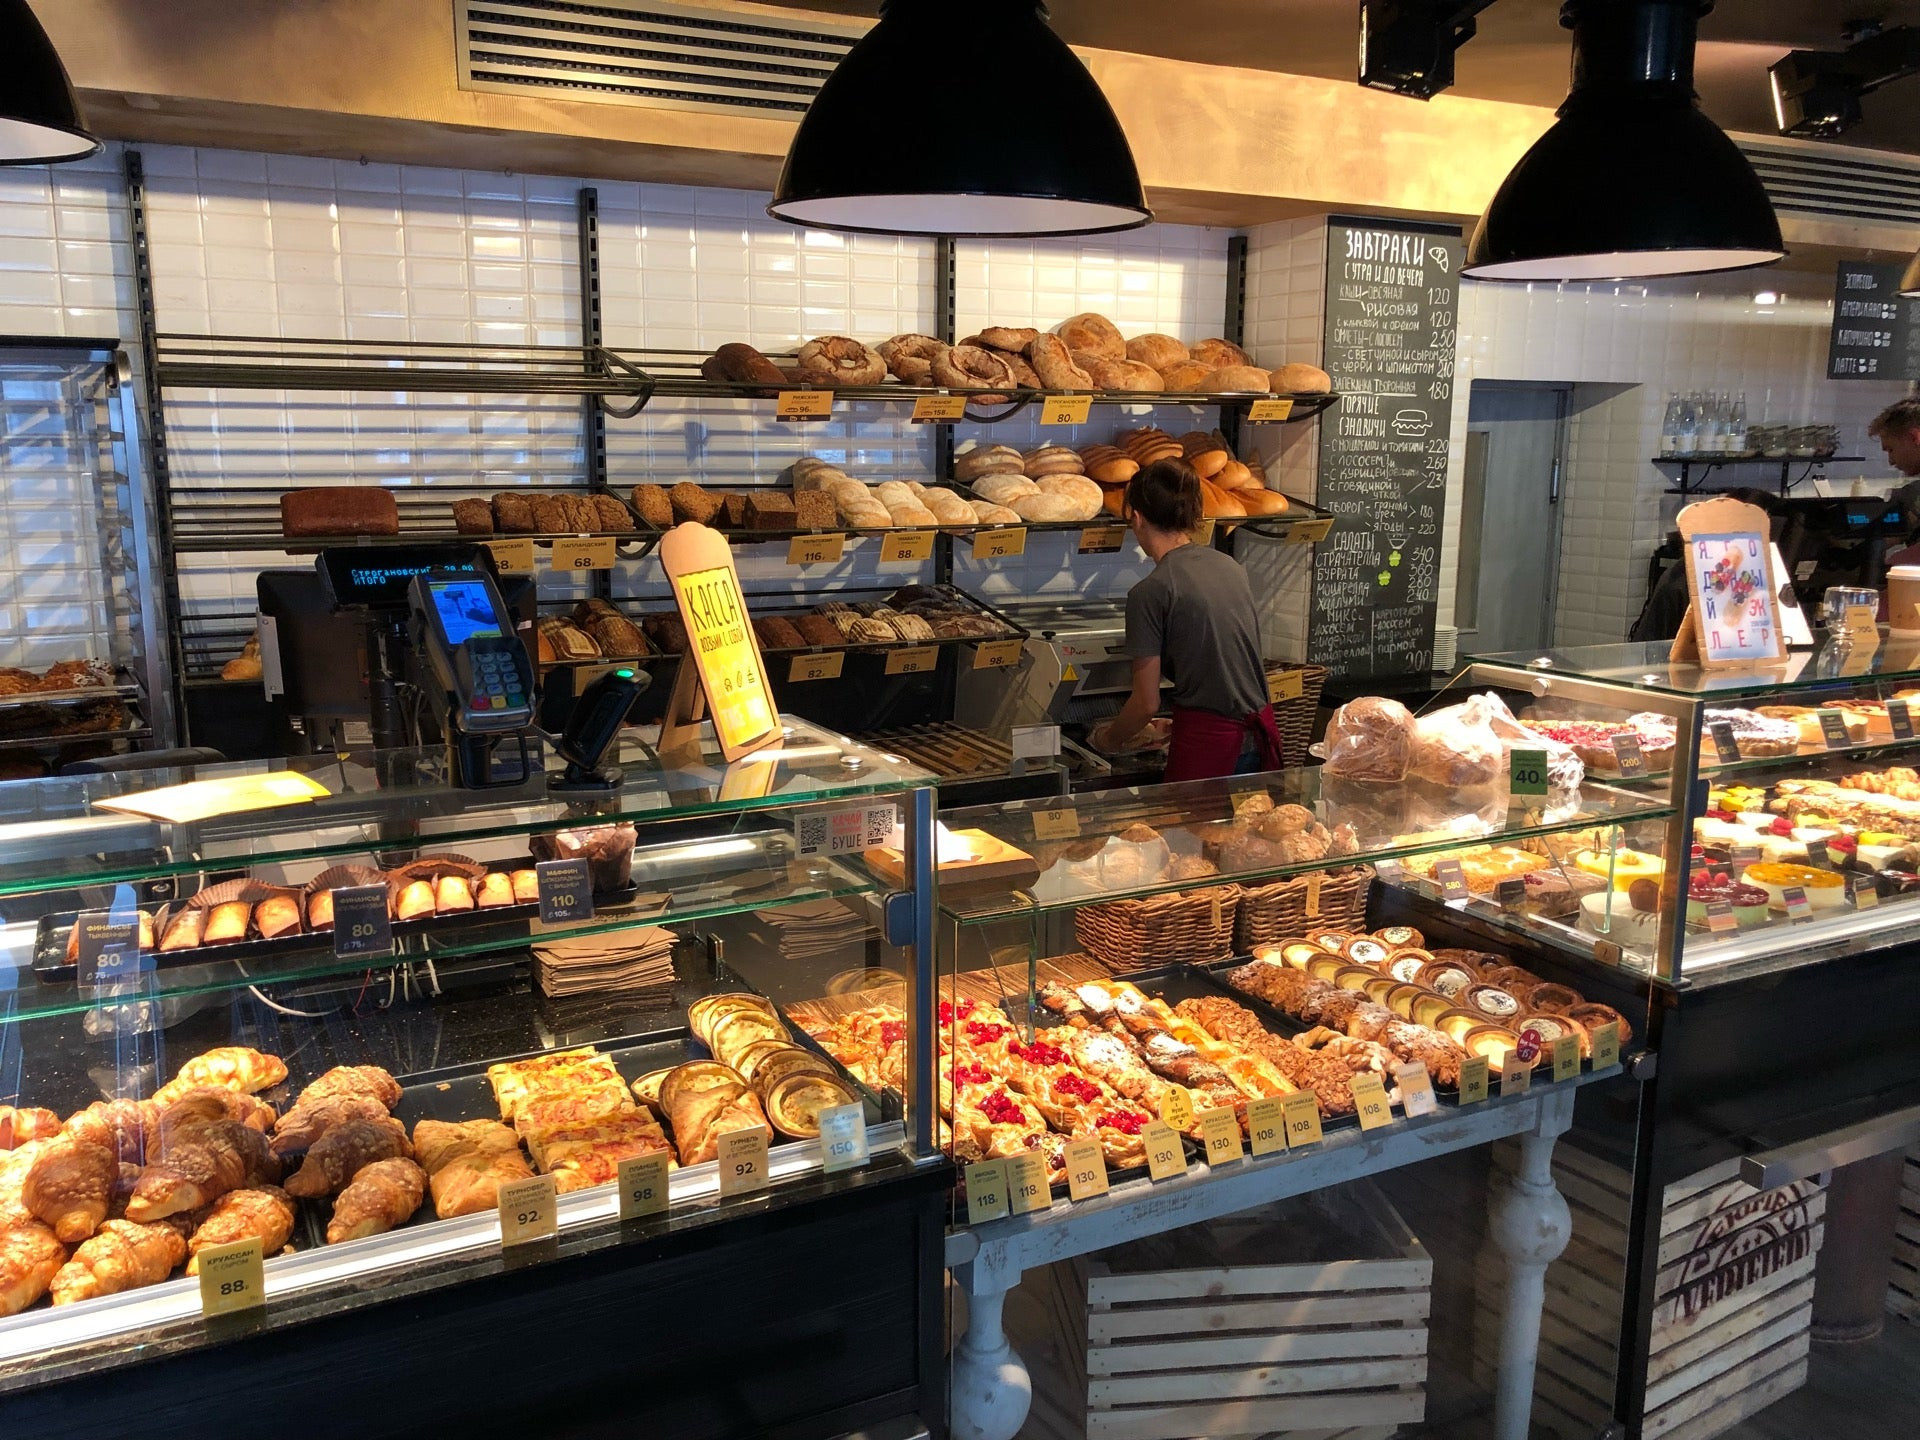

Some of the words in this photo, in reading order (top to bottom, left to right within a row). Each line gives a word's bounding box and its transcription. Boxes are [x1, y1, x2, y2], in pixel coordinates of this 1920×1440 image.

[1345, 230, 1425, 266] ЗАВТРАКИ
[1344, 263, 1349, 279] С
[1352, 264, 1372, 281] УТРА
[1374, 265, 1382, 282] И
[1382, 266, 1396, 284] ДО
[1397, 267, 1424, 287] ВЕЧЕРА
[1340, 283, 1362, 299] КАШИ
[1368, 285, 1403, 300] ОВСЯНАЯ
[1427, 287, 1450, 305] 120
[1366, 302, 1418, 317] РИСОВАЯ
[1430, 311, 1452, 327] 120
[1430, 329, 1455, 348] 250
[1355, 348, 1402, 361] ВЕТЧИНОЙ
[1411, 349, 1438, 361] СЫРОМ
[1438, 348, 1455, 362] 220
[1834, 357, 1857, 374] ЛАТТЕ
[1333, 376, 1372, 391] ЗАПЕКАНКА
[1374, 378, 1416, 392] ТВОРОЖНАЯ
[1427, 381, 1449, 400] 180
[1341, 395, 1380, 415] ГОРЯЧИЕ
[1057, 413, 1071, 422] 80
[1339, 416, 1386, 438] СЭНДВИЧИ
[1331, 439, 1338, 451] С
[1428, 438, 1449, 453] 220
[1338, 455, 1385, 467] ЛОСОСЕМ
[1426, 456, 1447, 470] 260
[1339, 467, 1386, 480] КУРИЦЕЙ
[1329, 481, 1335, 491] С
[1337, 481, 1392, 494] ГОВЯДИНОЙ
[1328, 501, 1364, 514] ТВОРОГ
[1417, 523, 1436, 535] 220
[1334, 531, 1375, 551] САЛАТЫ
[804, 551, 822, 561] 116
[897, 549, 912, 559] 88
[990, 546, 1004, 555] 76
[1315, 551, 1381, 568] СТРАЧАТЕЛЛА
[1411, 546, 1434, 563] 340
[574, 557, 591, 568] 68
[1317, 566, 1360, 581] БУРРАТА
[1408, 563, 1433, 577] 360
[353, 576, 386, 586] ИТОГО
[1408, 577, 1432, 589] 280
[1406, 588, 1429, 603] 240
[684, 579, 739, 633] КАССА
[1326, 608, 1357, 623] МИКС
[902, 663, 917, 672] 88
[989, 656, 1003, 666] 98
[808, 669, 822, 678] 82
[1274, 690, 1286, 700] 76
[1620, 758, 1640, 768] 1200
[1516, 769, 1540, 785] 40
[832, 833, 862, 850] БУШЕ
[546, 867, 578, 877] МАФФИН
[551, 894, 575, 908] 110
[554, 910, 568, 918] 105
[86, 923, 132, 932] ФИНАНСЬЕ
[352, 924, 373, 937] 80
[97, 953, 121, 968] 80
[1468, 1081, 1480, 1092] 98
[1363, 1103, 1381, 1115] 108
[1293, 1120, 1310, 1133] 108
[729, 1135, 758, 1147] ТУРНЕЛЬ
[1256, 1128, 1273, 1141] 108
[830, 1140, 853, 1156] 150
[1211, 1137, 1229, 1150] 130
[1154, 1150, 1173, 1164] 130
[735, 1161, 754, 1176] 92
[1075, 1170, 1095, 1184] 130
[507, 1182, 545, 1197] ТУРНОВЕР
[633, 1188, 652, 1202] 98
[1019, 1184, 1037, 1198] 118
[977, 1193, 996, 1207] 118
[517, 1210, 538, 1225] 92
[207, 1249, 254, 1266] КРУАССАН
[220, 1279, 244, 1296] 88
